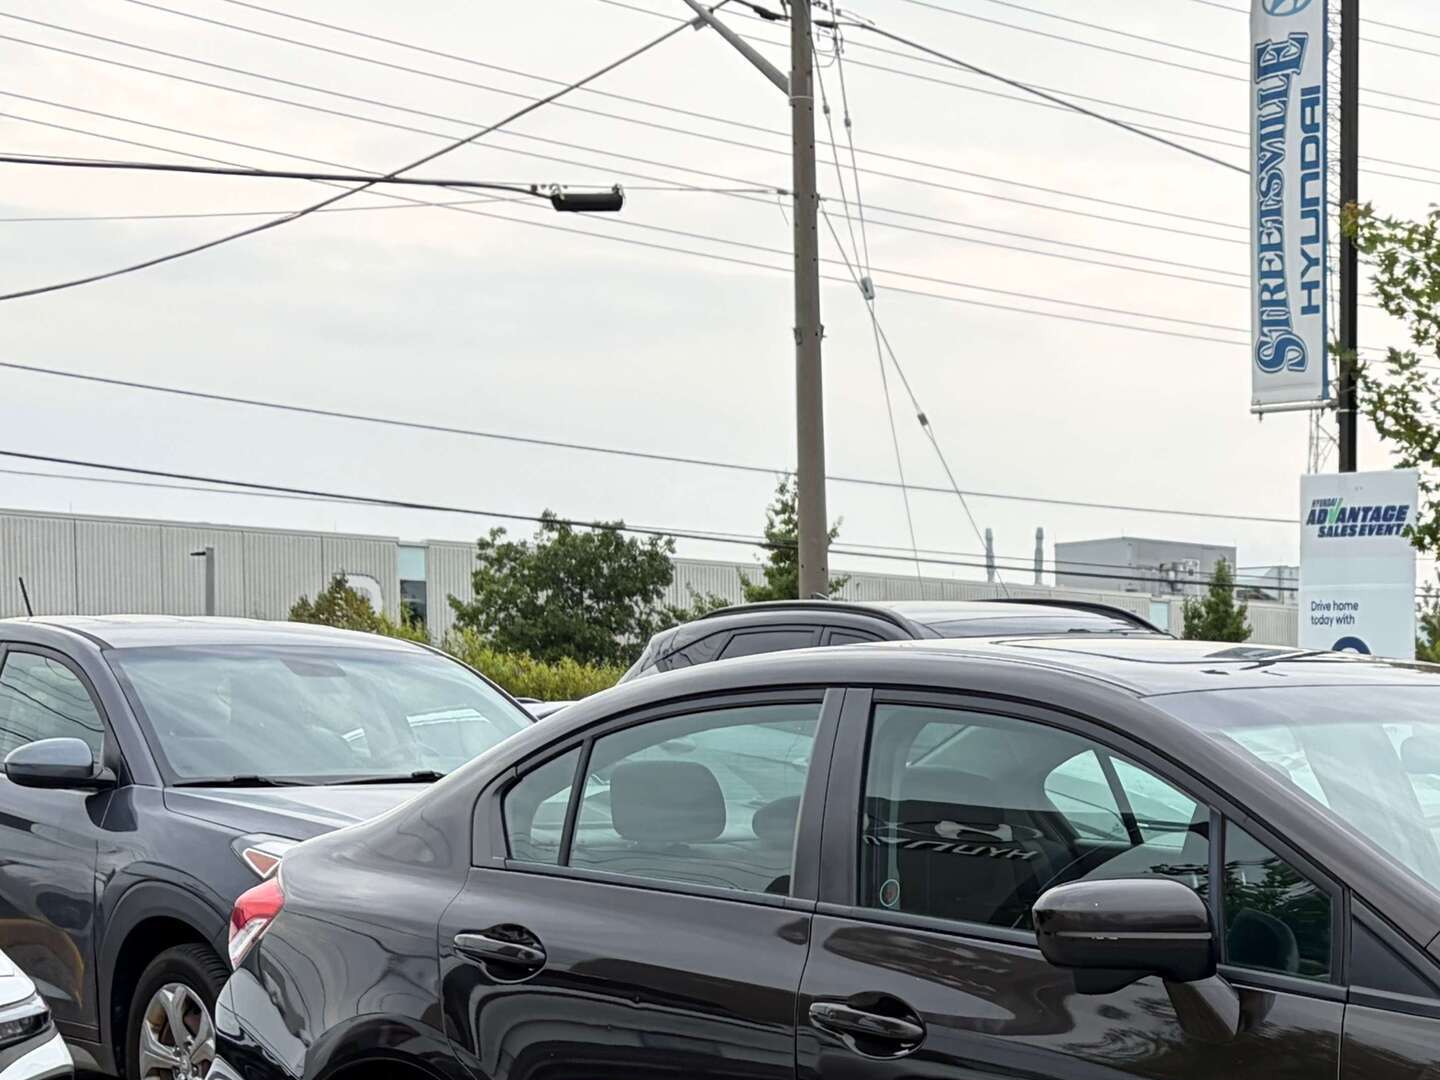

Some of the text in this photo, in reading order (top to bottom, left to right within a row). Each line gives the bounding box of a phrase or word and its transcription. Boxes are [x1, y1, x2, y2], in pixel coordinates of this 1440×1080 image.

[1254, 31, 1310, 374] STREETSVILLE
[1300, 84, 1322, 317] HYUNDAI
[1306, 501, 1410, 525] ADVANTAGE
[1318, 523, 1404, 538] SALES EVENT
[1311, 600, 1359, 612] Drive home
[1311, 613, 1355, 628] today with
